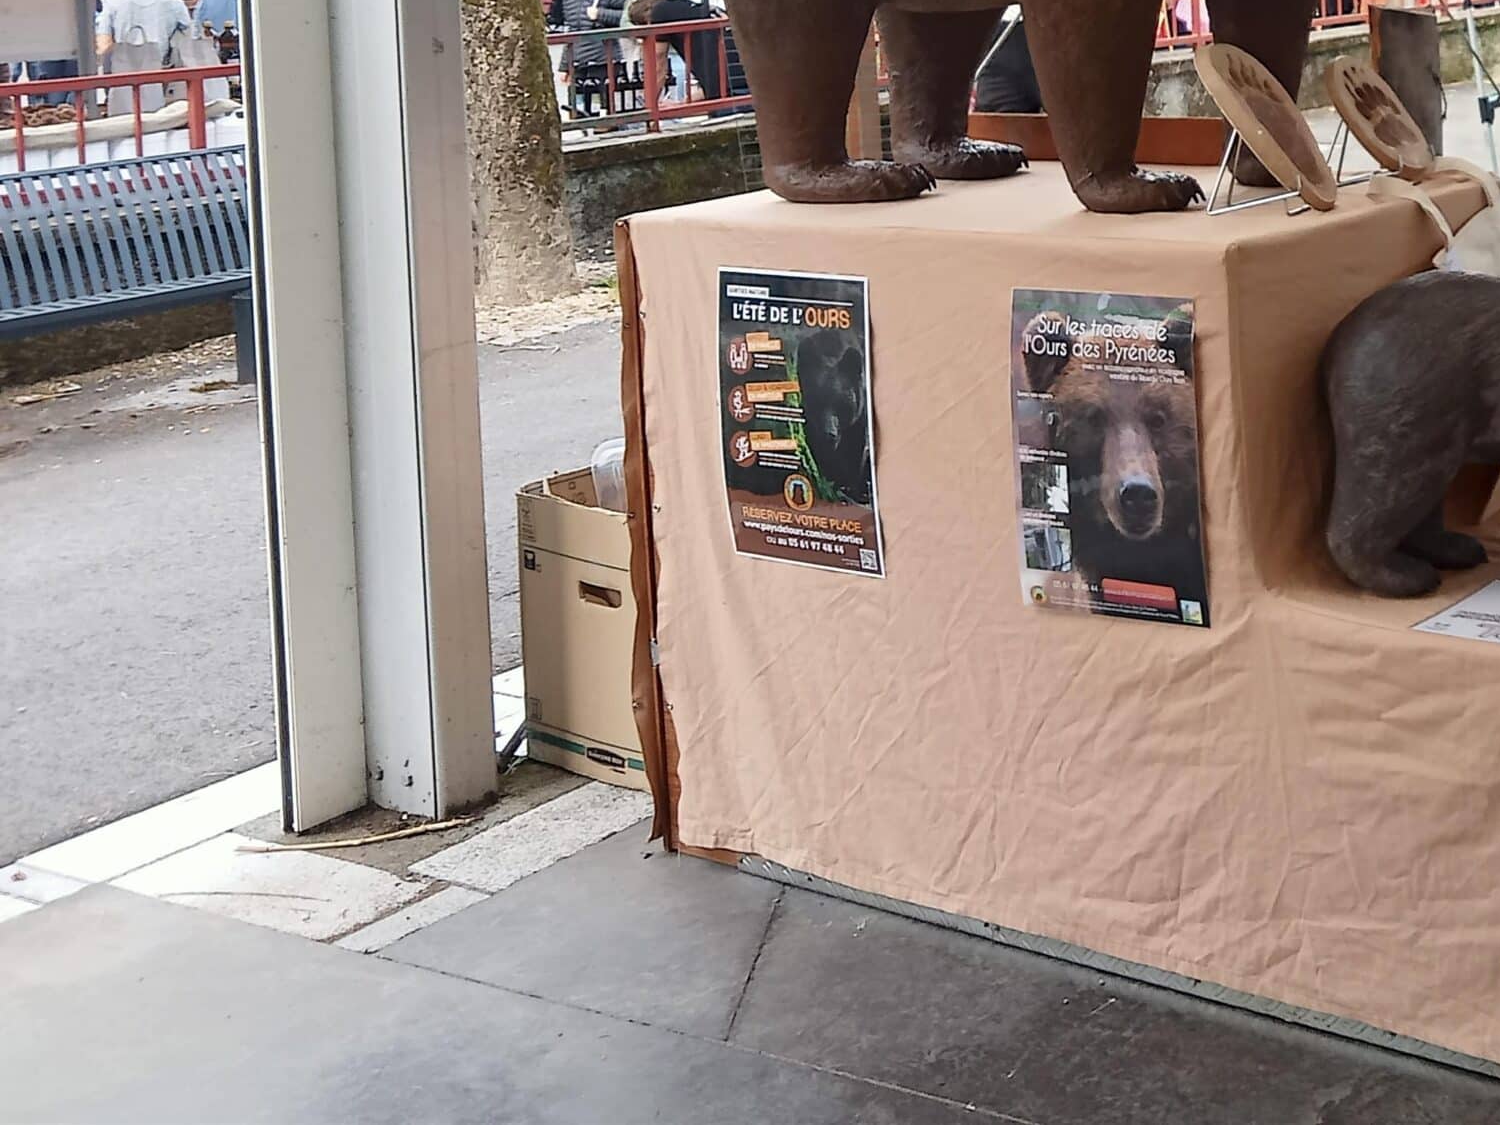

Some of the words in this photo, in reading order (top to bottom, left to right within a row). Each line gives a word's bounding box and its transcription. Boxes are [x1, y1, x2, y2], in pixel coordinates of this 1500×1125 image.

[733, 300, 767, 321] L'ÉTÉ
[770, 305, 788, 323] DE
[792, 308, 802, 324] L'
[804, 307, 850, 329] OURS
[1038, 315, 1064, 334] Sur
[1066, 316, 1086, 336] les
[1091, 319, 1140, 339] traces
[1146, 321, 1168, 342] de
[1025, 334, 1067, 356] l'Ours
[1072, 340, 1101, 358] des
[1105, 339, 1176, 364] Pyrénées
[795, 514, 828, 529] VOTRE
[829, 518, 862, 533] PLACE
